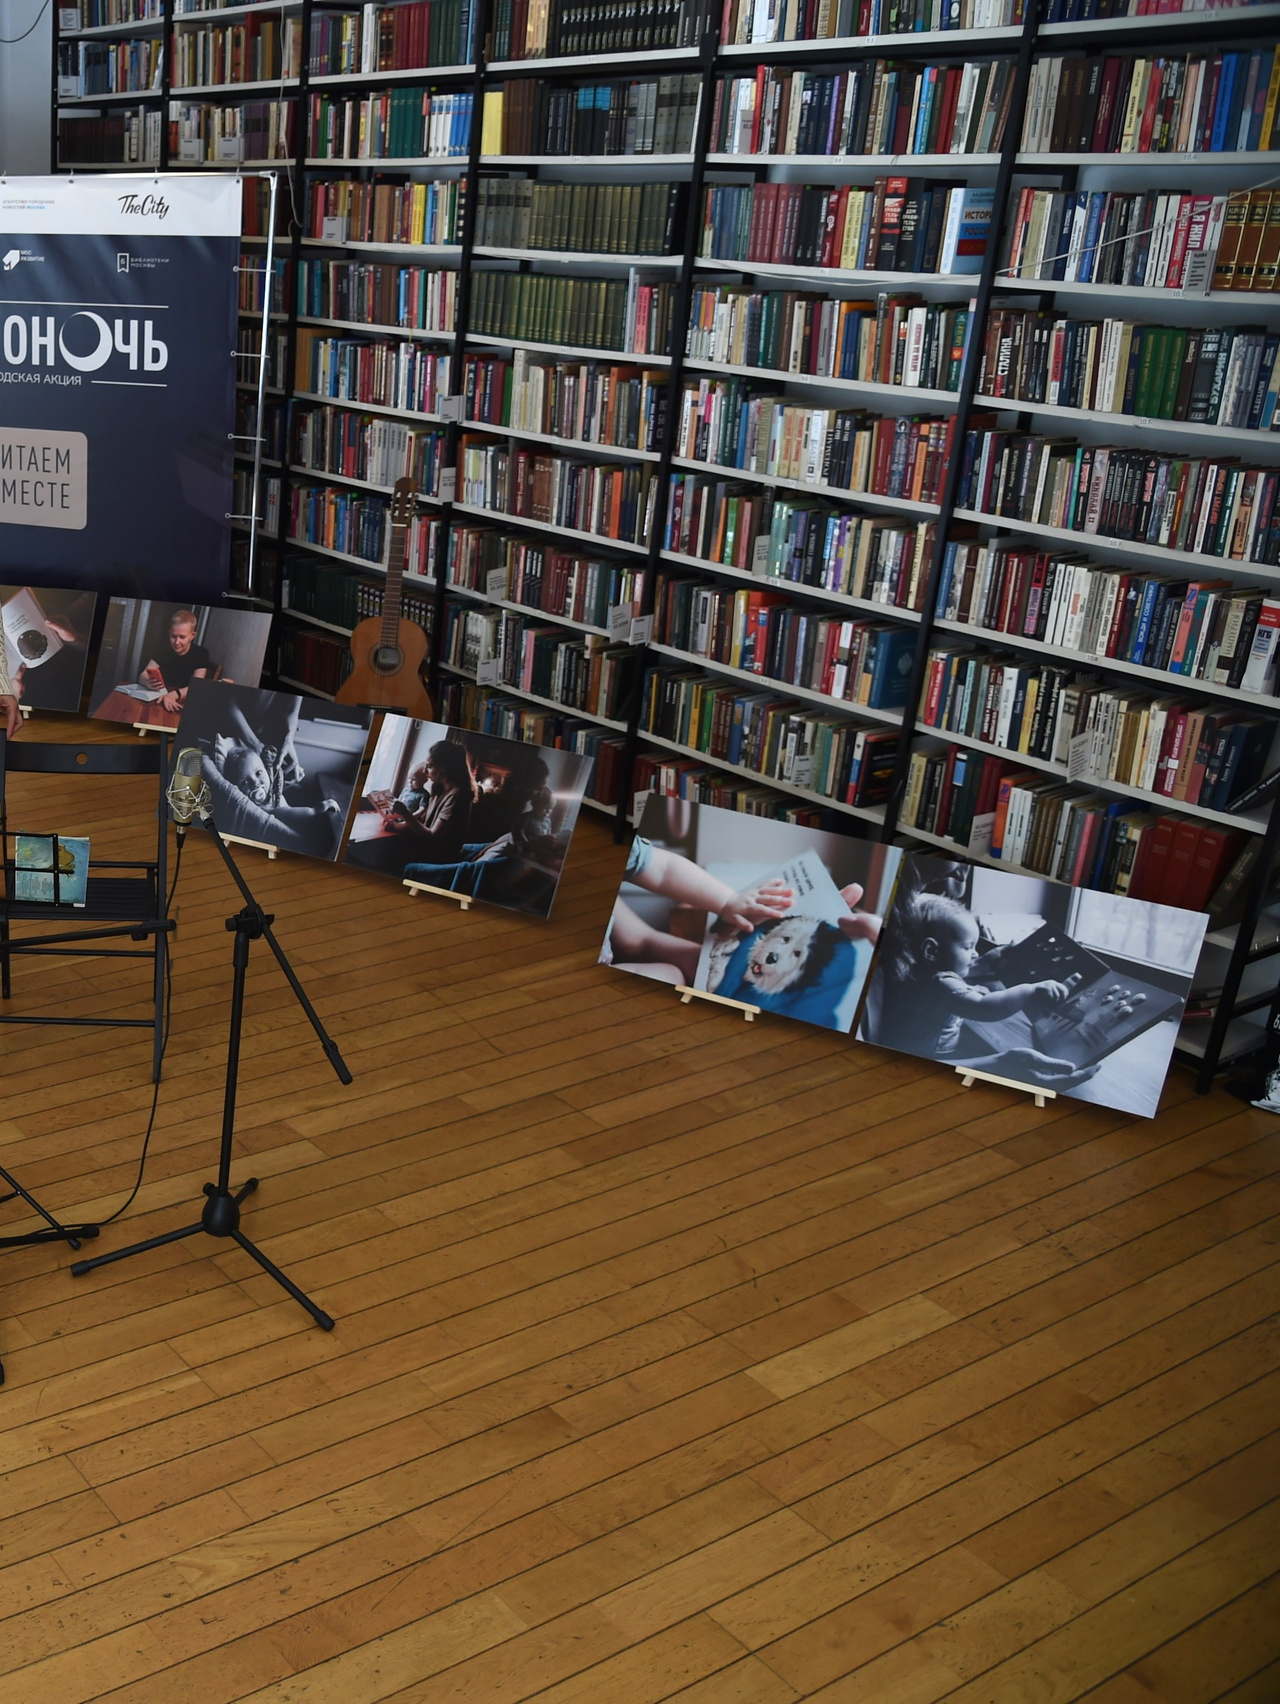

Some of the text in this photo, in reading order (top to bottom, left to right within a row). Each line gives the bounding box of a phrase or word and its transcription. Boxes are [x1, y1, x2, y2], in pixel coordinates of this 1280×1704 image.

[1186, 222, 1203, 249] ЖИЛ
[910, 354, 918, 371] БИТВА
[997, 336, 1013, 375] СТАЛИНА
[43, 374, 81, 387] АКЦИЯ
[1209, 351, 1226, 404] БУХАРИН
[1088, 475, 1102, 514] НИКОЛАЙ
[1209, 495, 1221, 524] ПОРТРЕТ
[1137, 622, 1146, 642] ВОЖДИ
[1143, 584, 1154, 615] СОВЕТНИКИ
[1148, 624, 1156, 644] ВОЖДИ
[1153, 586, 1165, 618] СОВЕТНИКИ
[1224, 613, 1240, 655] ИМПЕРИЯ
[1258, 629, 1272, 639] КГБ
